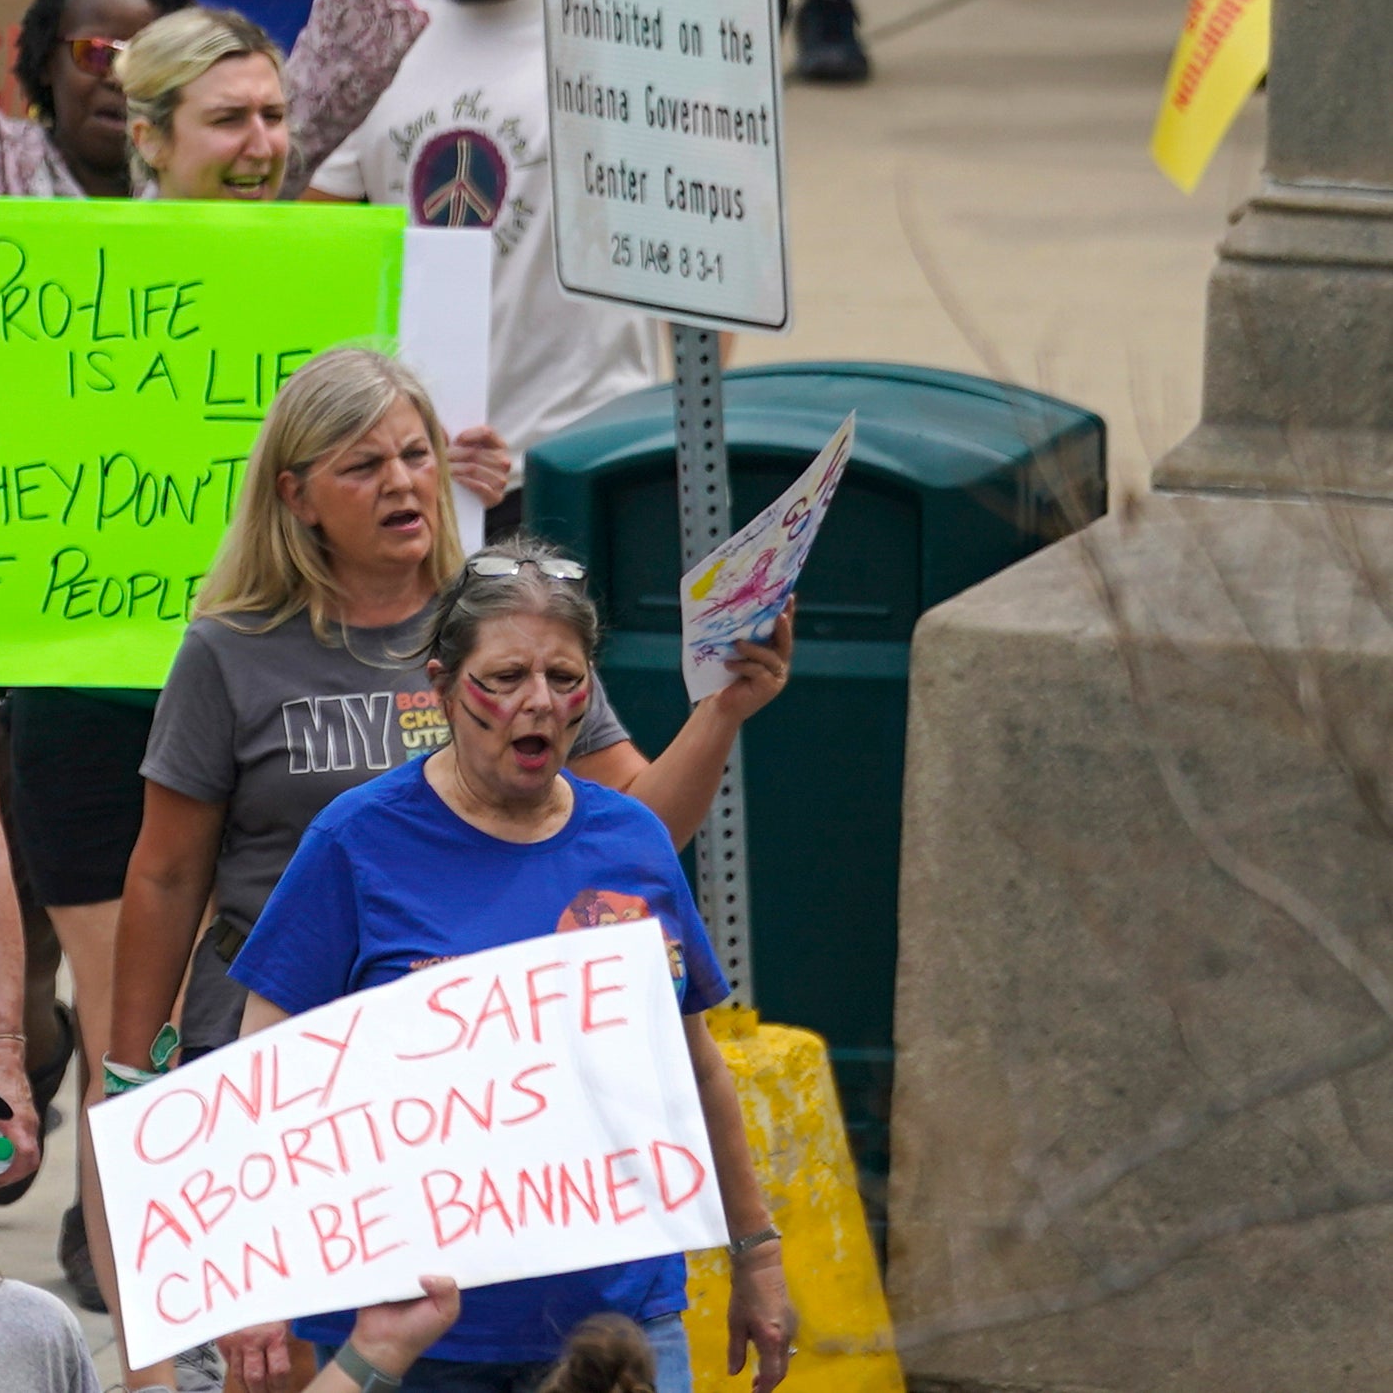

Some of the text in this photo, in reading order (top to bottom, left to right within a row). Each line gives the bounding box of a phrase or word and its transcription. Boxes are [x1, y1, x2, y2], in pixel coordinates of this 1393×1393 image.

[678, 19, 704, 58] on
[718, 19, 754, 66] the
[554, 68, 771, 148] Indiana Government
[582, 152, 746, 224] Center Campus
[610, 235, 633, 267] 25
[679, 245, 692, 277] 8
[68, 350, 115, 399] IS
[136, 352, 180, 400] A
[97, 452, 249, 531] DON'T
[282, 691, 395, 774] MY
[133, 954, 629, 1166] ONLY SAFE
[135, 1062, 557, 1272] ABORTIONS
[155, 1139, 707, 1326] CAN BE BANNED
